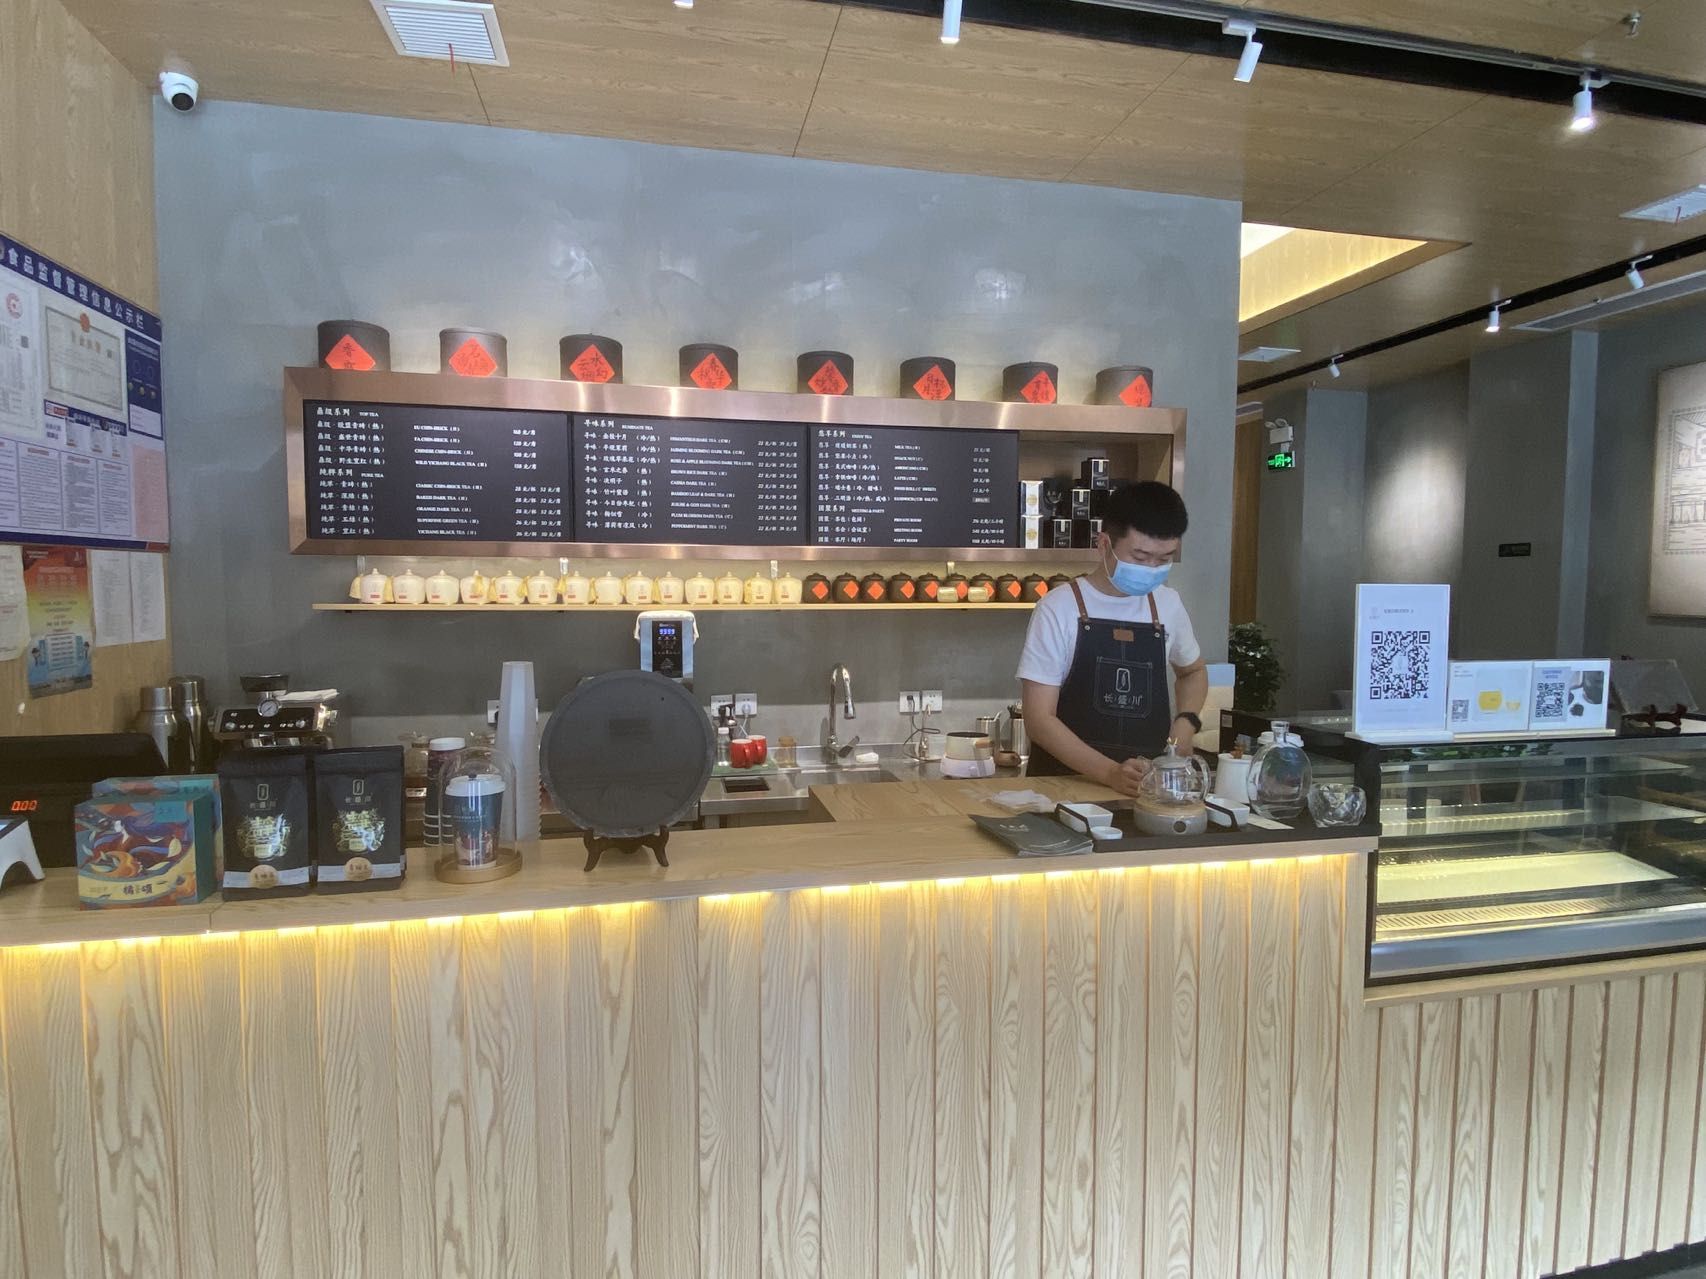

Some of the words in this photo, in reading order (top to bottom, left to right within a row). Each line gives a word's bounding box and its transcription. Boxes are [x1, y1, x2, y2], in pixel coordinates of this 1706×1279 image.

[8, 248, 144, 329] 食品监督管理信息公示栏
